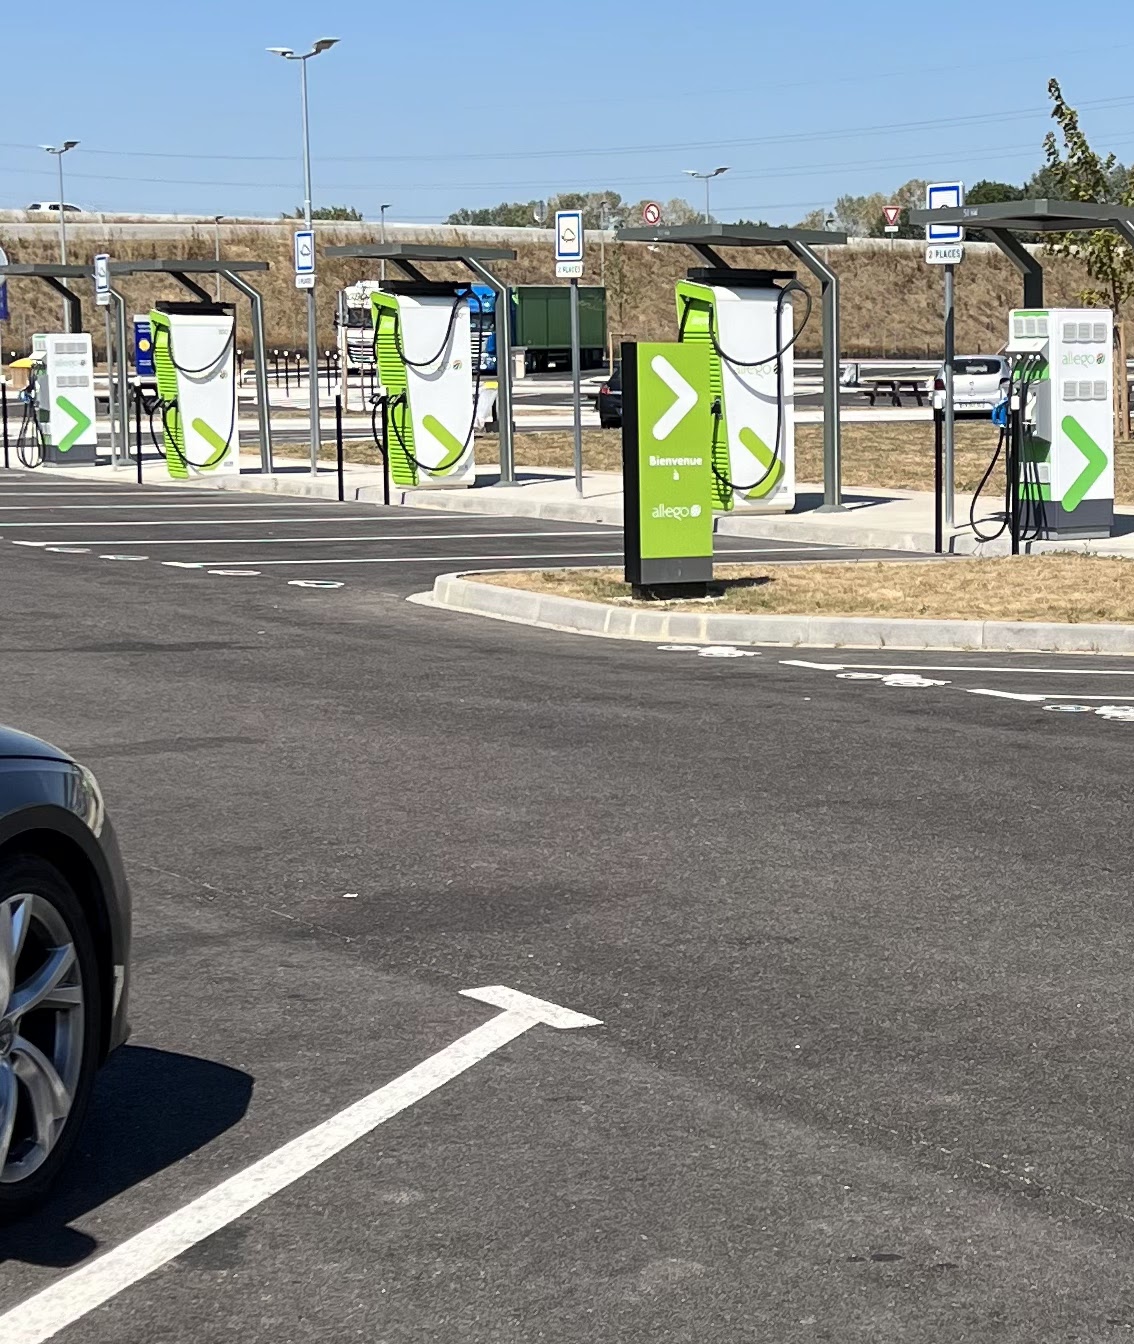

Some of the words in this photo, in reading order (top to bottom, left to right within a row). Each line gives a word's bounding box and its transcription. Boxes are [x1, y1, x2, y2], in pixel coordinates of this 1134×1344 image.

[928, 250, 933, 259] 2
[935, 249, 960, 259] PLACES
[1061, 351, 1096, 369] allego
[649, 455, 703, 467] Bienvenue
[672, 468, 680, 481] à
[651, 503, 690, 522] allego
